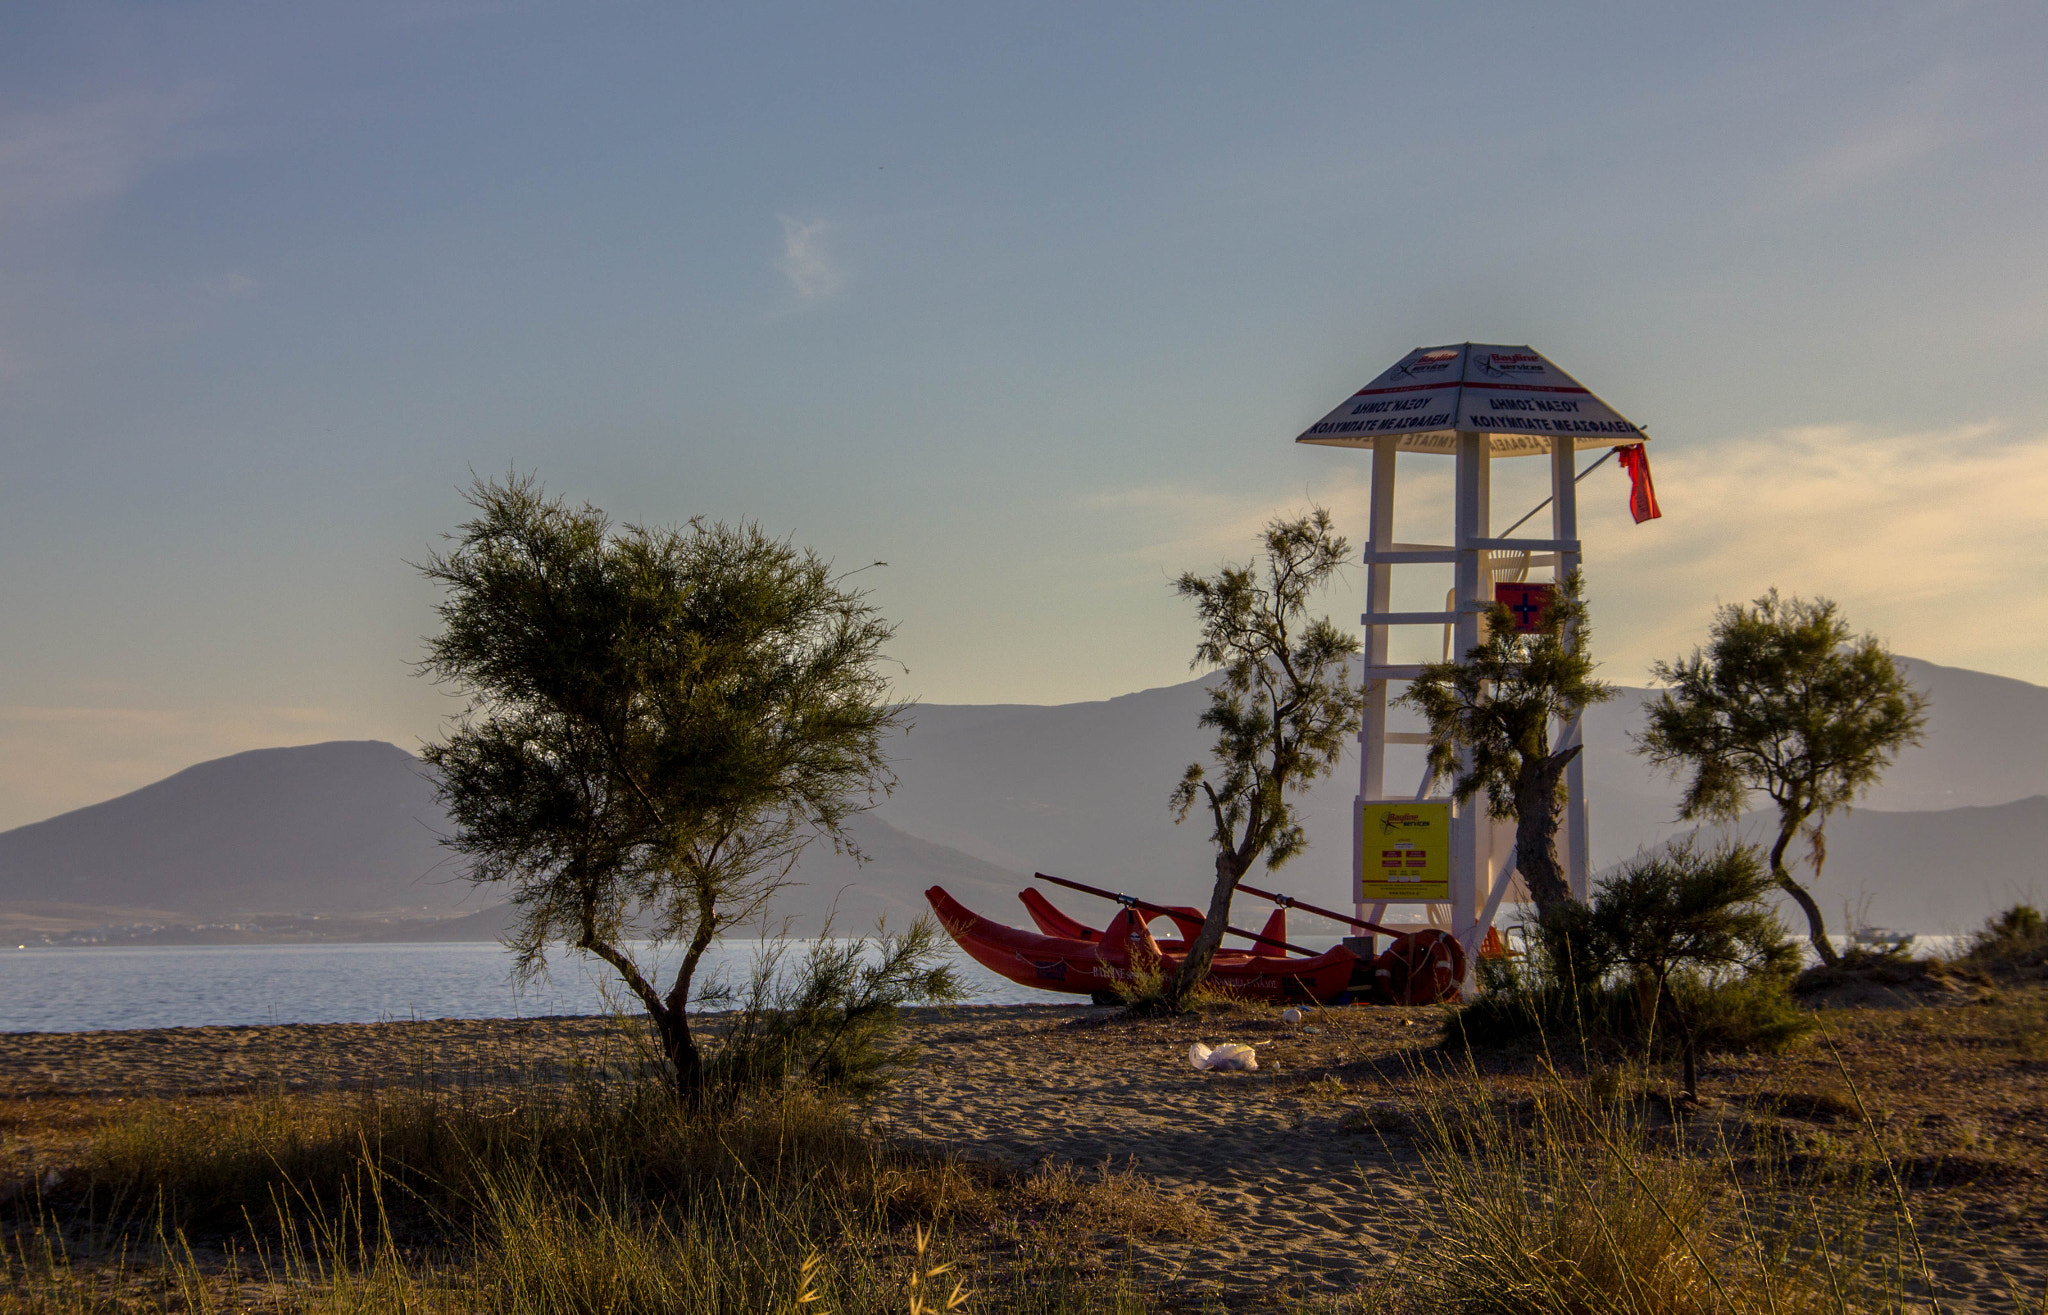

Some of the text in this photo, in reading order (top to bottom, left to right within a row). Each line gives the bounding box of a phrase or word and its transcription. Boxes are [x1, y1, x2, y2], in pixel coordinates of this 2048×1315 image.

[1418, 353, 1458, 365] Bayline
[1491, 353, 1539, 364] Bayline
[1412, 363, 1450, 371] services
[1351, 398, 1432, 415] ΔΗΜΟΣ ΝΑΞΟΥ
[1489, 398, 1579, 413] ΔΗΜΟΣ ΝΑΞΟΥ
[1310, 420, 1378, 434] ΚΟΛΥΜΠΑΤΕ
[1470, 415, 1552, 431] ΚΟΛΥΜΠΑΤΕ
